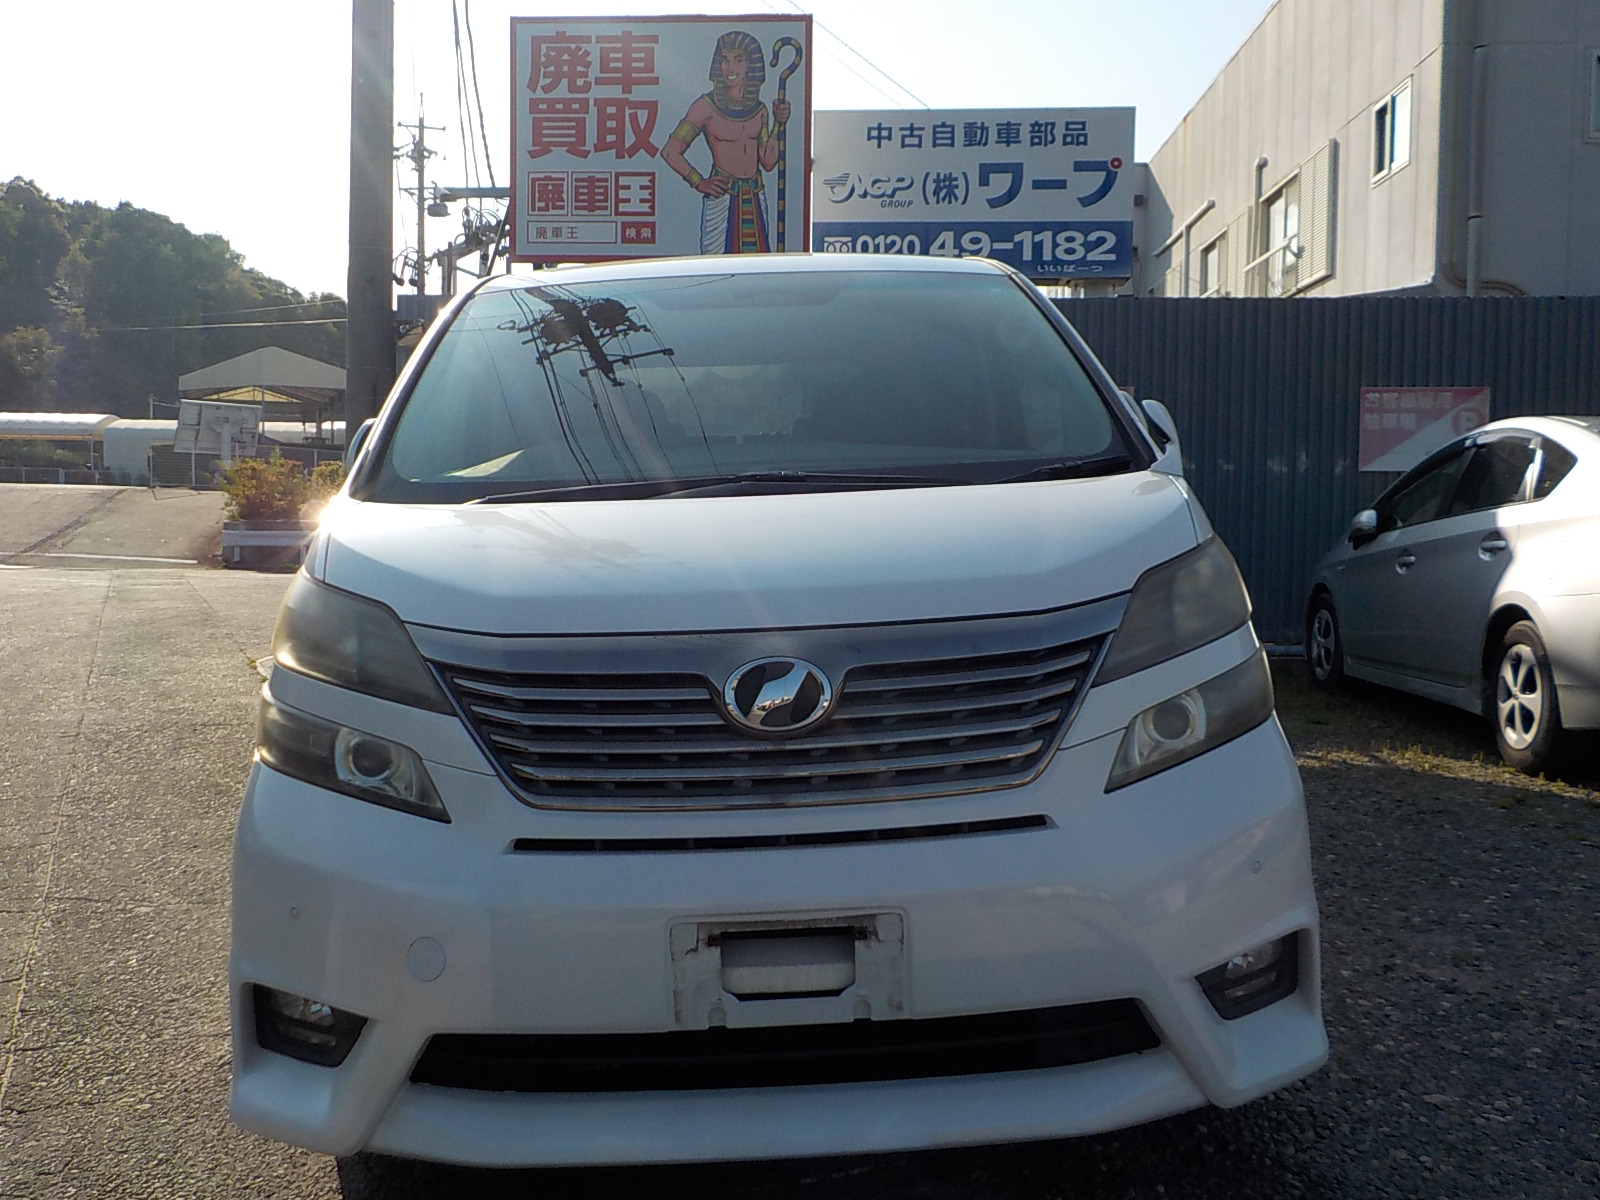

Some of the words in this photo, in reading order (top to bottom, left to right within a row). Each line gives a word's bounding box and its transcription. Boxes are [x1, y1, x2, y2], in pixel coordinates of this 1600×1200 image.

[526, 30, 660, 95] 廃車
[526, 97, 660, 160] 買取
[866, 119, 1090, 149] 中古自動車部品
[529, 173, 656, 214] 廃車王
[880, 199, 914, 208] GROUP
[535, 226, 579, 240] 廃車王
[625, 226, 652, 239] 検索
[929, 230, 1117, 261] 49-1182
